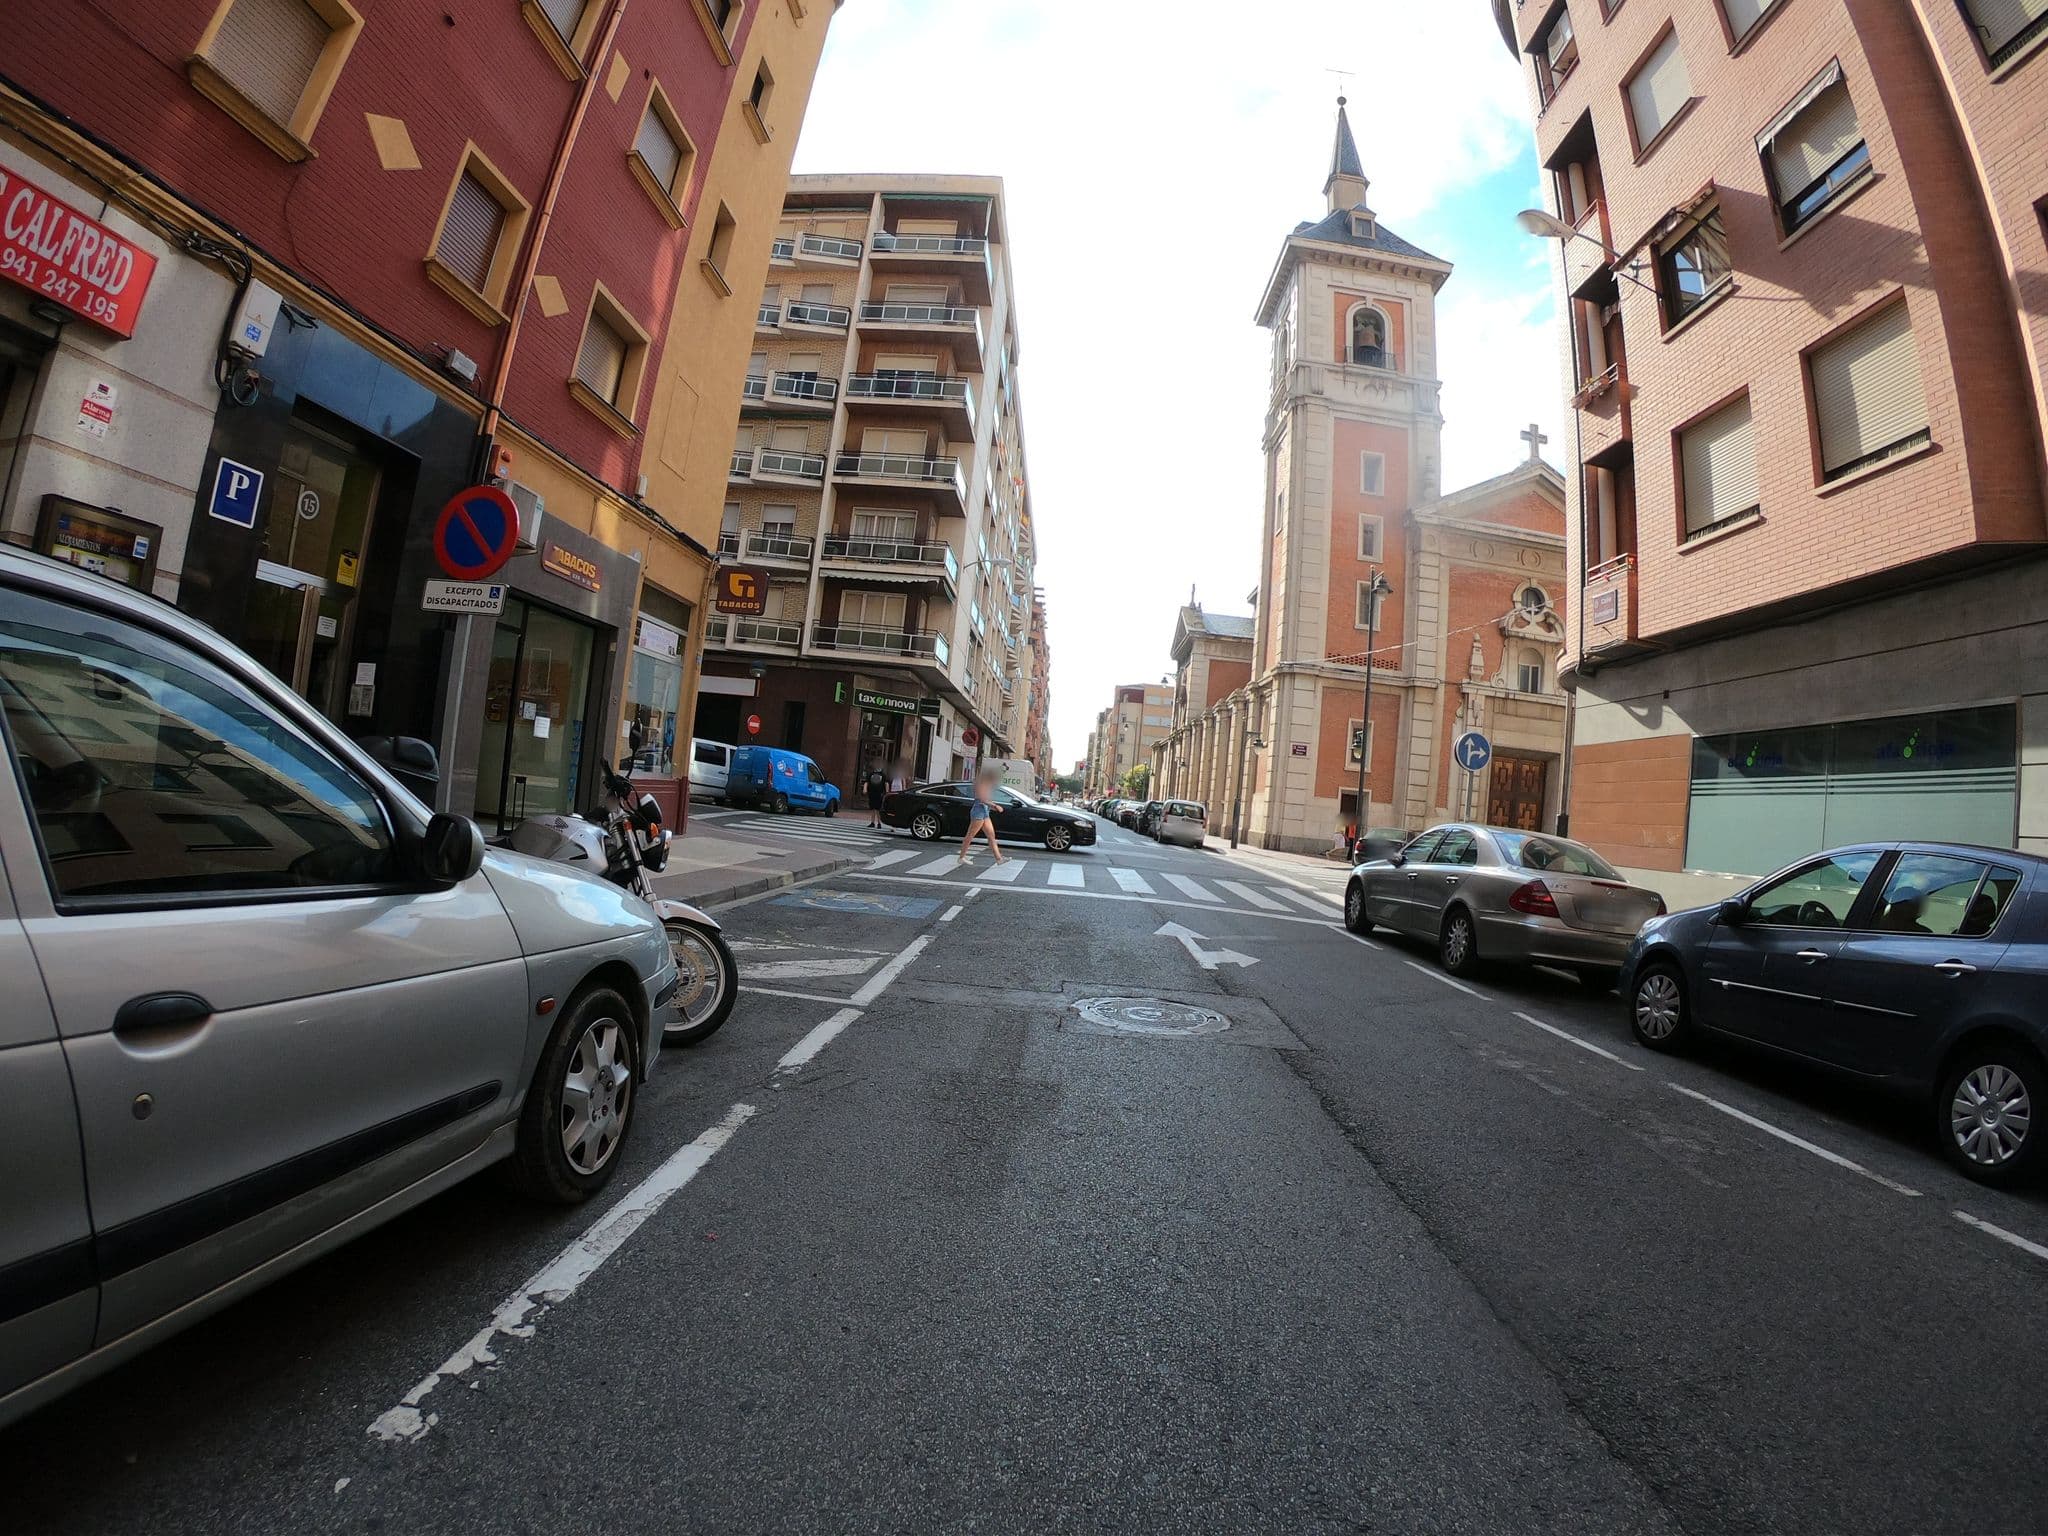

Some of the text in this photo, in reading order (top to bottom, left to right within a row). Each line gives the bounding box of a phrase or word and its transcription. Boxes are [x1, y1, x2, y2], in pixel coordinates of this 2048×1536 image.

[4, 187, 133, 295] CALFRED
[0, 247, 119, 323] 941 247 195
[225, 470, 250, 500] P
[303, 498, 316, 513] 15
[553, 545, 597, 579] TABACOS
[445, 586, 483, 596] EXCEPTO
[426, 596, 498, 609] DISCAPACITADOS
[718, 600, 760, 609] TABACOS
